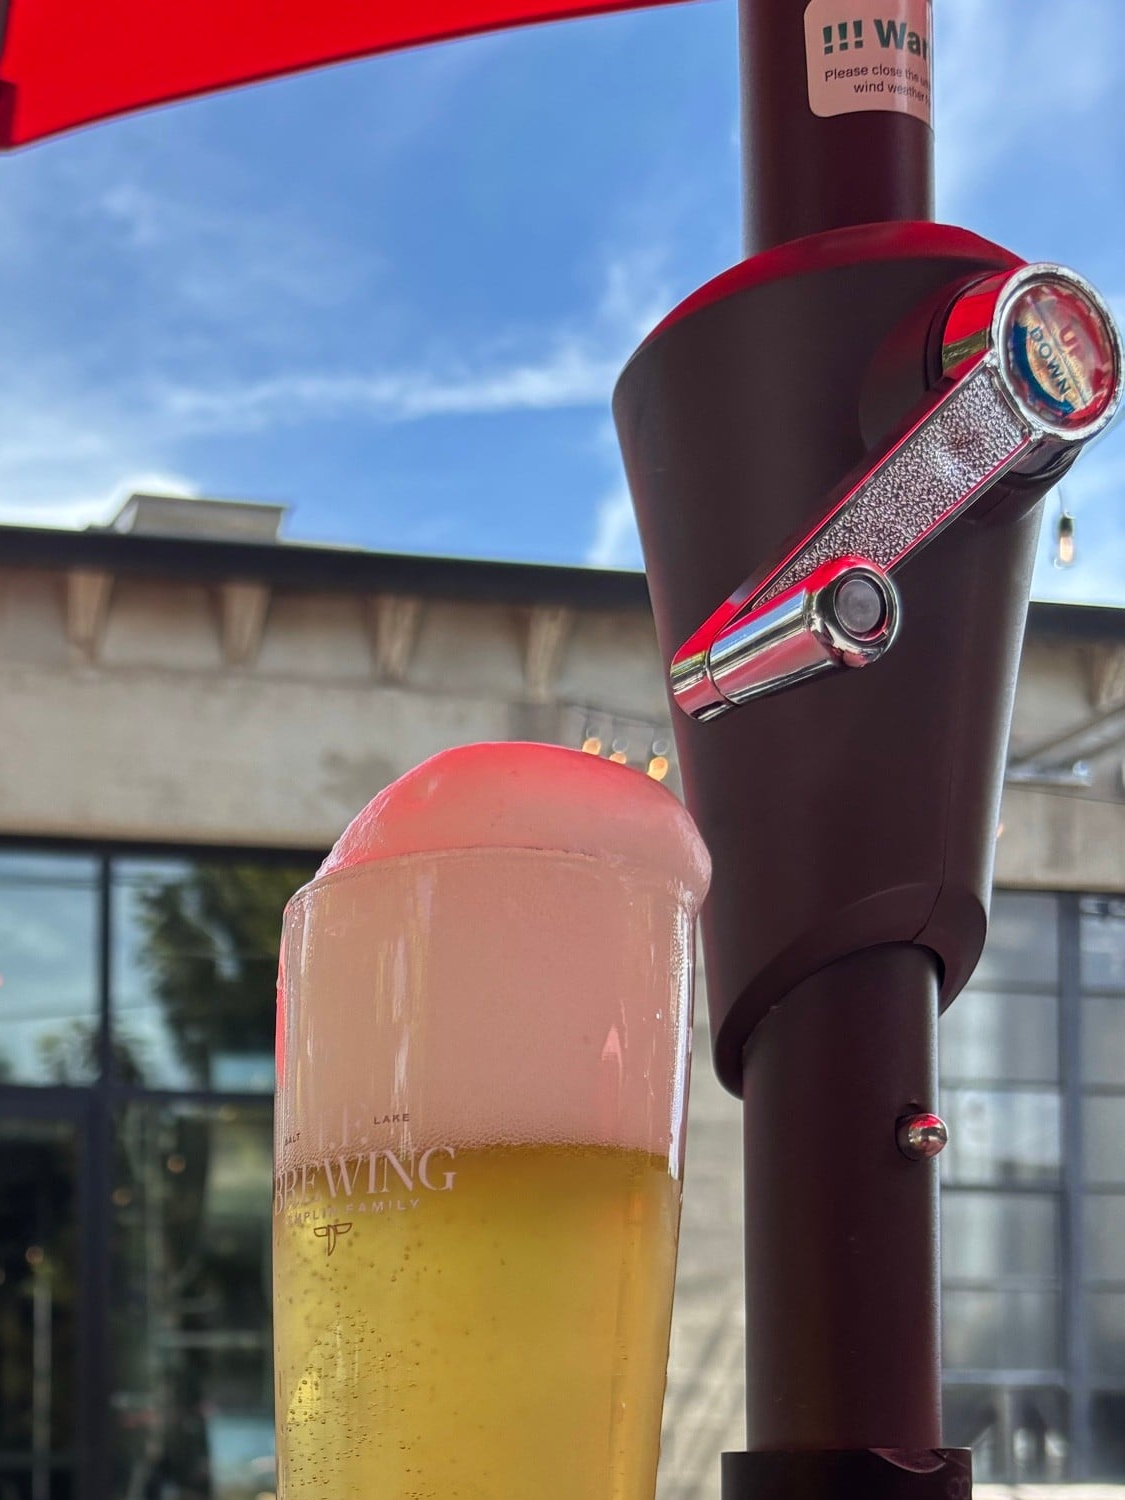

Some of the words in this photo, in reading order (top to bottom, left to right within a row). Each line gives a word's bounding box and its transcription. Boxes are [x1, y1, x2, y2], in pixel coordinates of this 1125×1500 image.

[825, 65, 869, 82] Please
[872, 64, 902, 78] close
[905, 69, 920, 84] the
[854, 82, 884, 94] wind
[1030, 326, 1072, 397] DOWN
[373, 1113, 411, 1125] LAKE
[275, 1147, 458, 1217] BREWING
[346, 1198, 420, 1214] FAMILY
